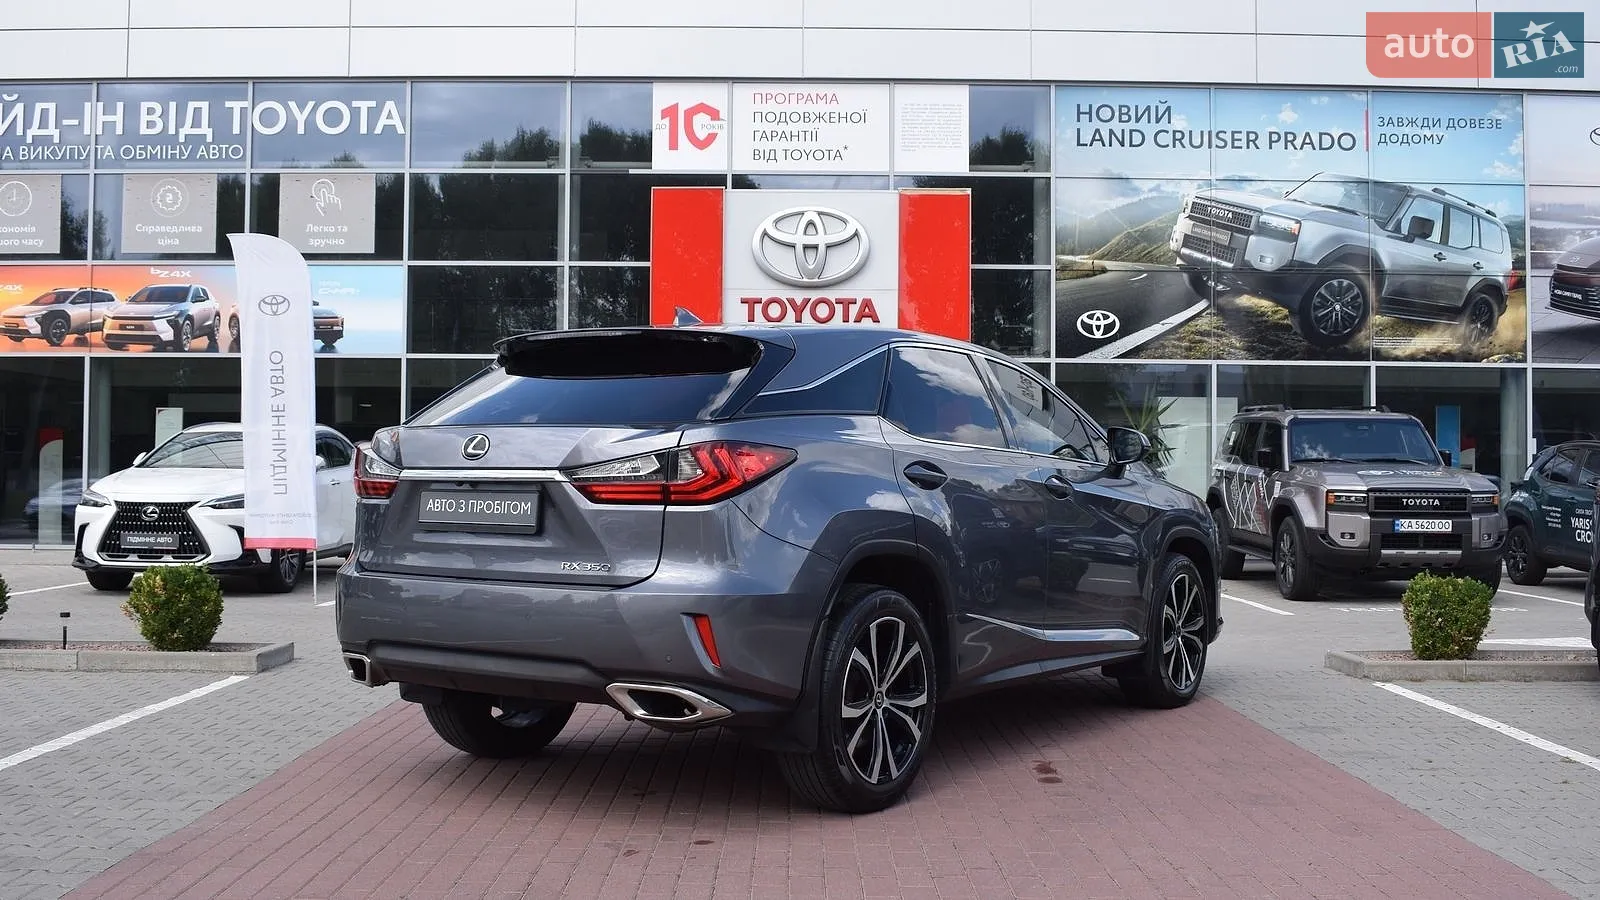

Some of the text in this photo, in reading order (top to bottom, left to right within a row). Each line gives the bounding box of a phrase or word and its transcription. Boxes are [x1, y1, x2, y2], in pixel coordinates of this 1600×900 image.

[753, 92, 839, 105] ПРОГРАМА
[753, 109, 868, 126] ПОДОВЖЕНОЇ
[1076, 100, 1172, 125] НОВИЙ
[140, 101, 212, 143] ВІД
[225, 100, 406, 136] TOYOTA
[655, 123, 667, 131] ДО
[1377, 116, 1503, 132] ЗАВЖДИ ДОВЕЗЕ
[753, 128, 819, 142] ГАРАНТІЇ
[1076, 128, 1357, 152] LAND CRUISER PRADO
[1377, 131, 1445, 147] ДОДОМУ
[20, 145, 90, 160] ВИКУПУ
[96, 145, 115, 160] ТА
[120, 144, 192, 160] ОБМІНУ
[197, 144, 244, 160] АВТО
[753, 148, 778, 164] ВІД
[1207, 207, 1233, 218] TOYOTA
[135, 224, 203, 235] Справедлива
[306, 224, 348, 233] Легко та
[22, 239, 44, 248] часу
[158, 237, 180, 246] ціна
[308, 238, 345, 248] зручно
[740, 297, 881, 323] TOYOTA
[426, 499, 531, 515] АВТО З ПРОБІГОМ
[1400, 520, 1413, 530] KA
[1415, 520, 1435, 530] 5620
[1570, 516, 1590, 529] YARIS
